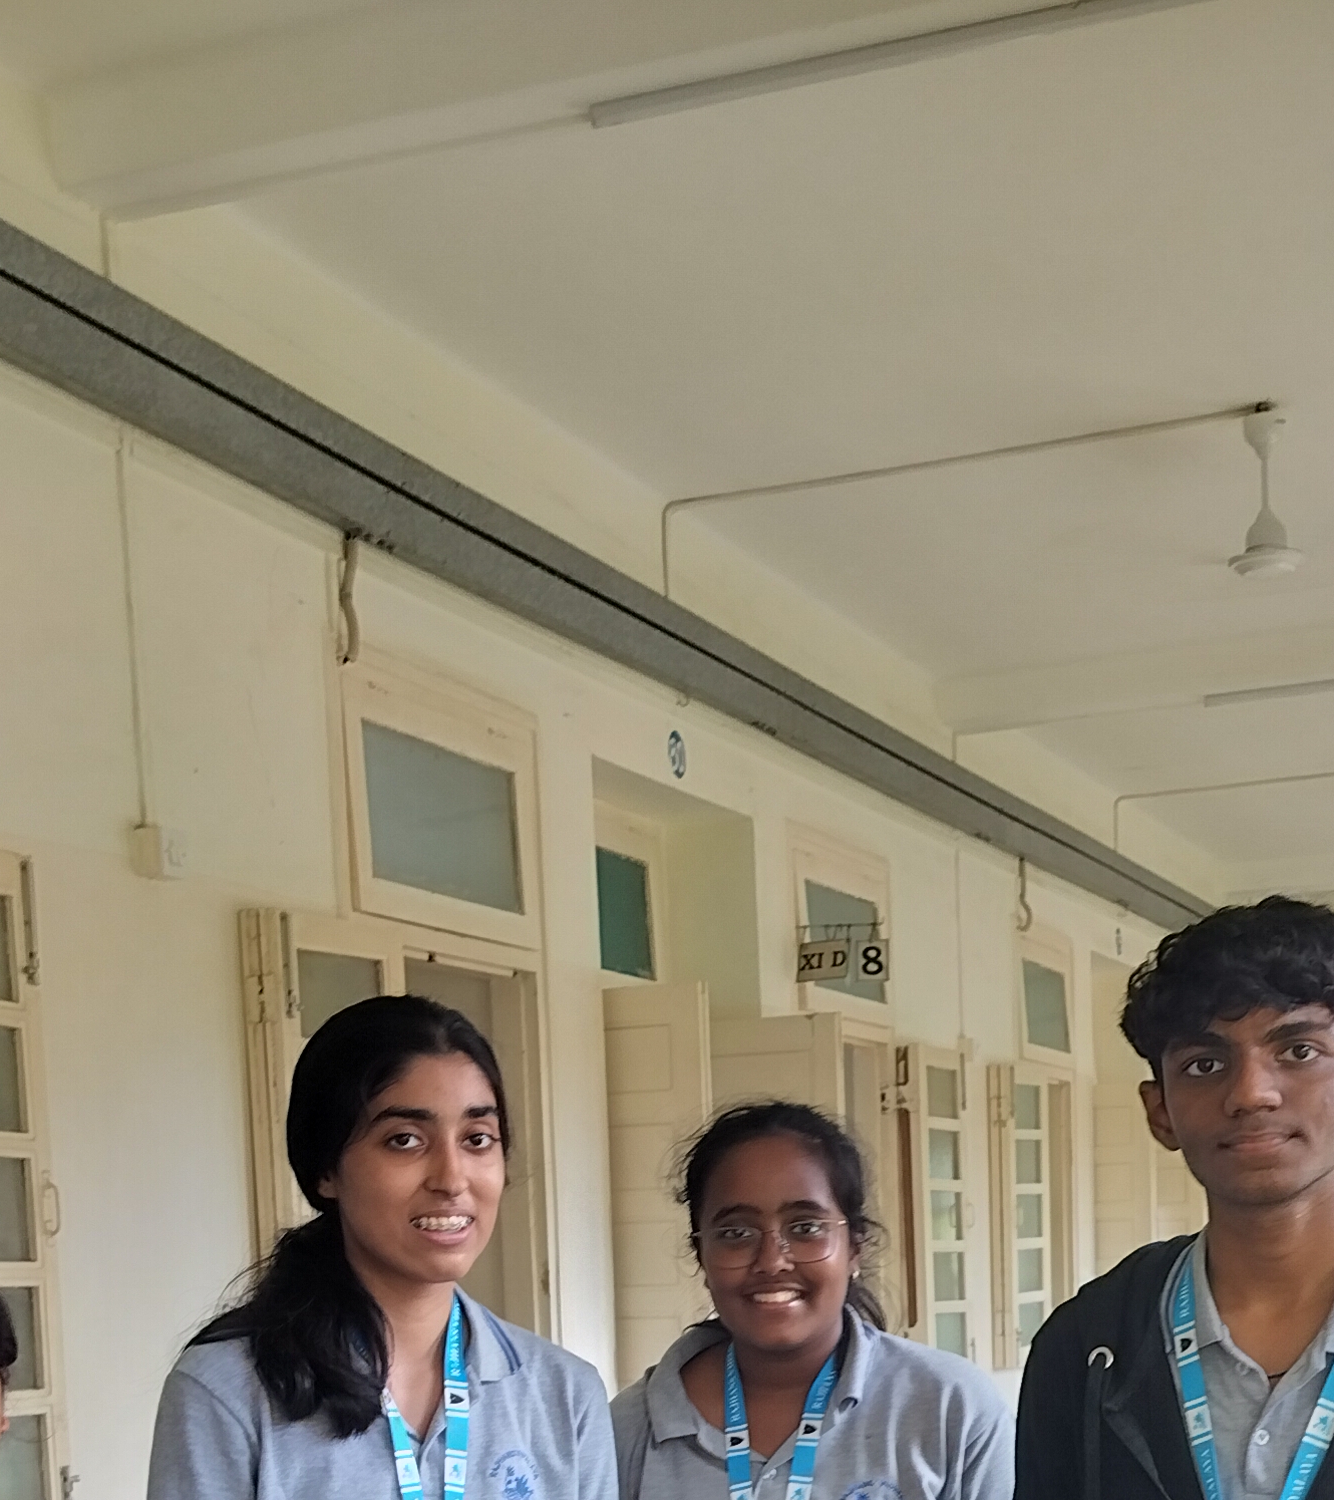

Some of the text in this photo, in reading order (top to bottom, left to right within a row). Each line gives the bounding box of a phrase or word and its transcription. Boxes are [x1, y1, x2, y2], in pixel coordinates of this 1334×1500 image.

[799, 950, 847, 971] XI D
[862, 946, 883, 975] 8
